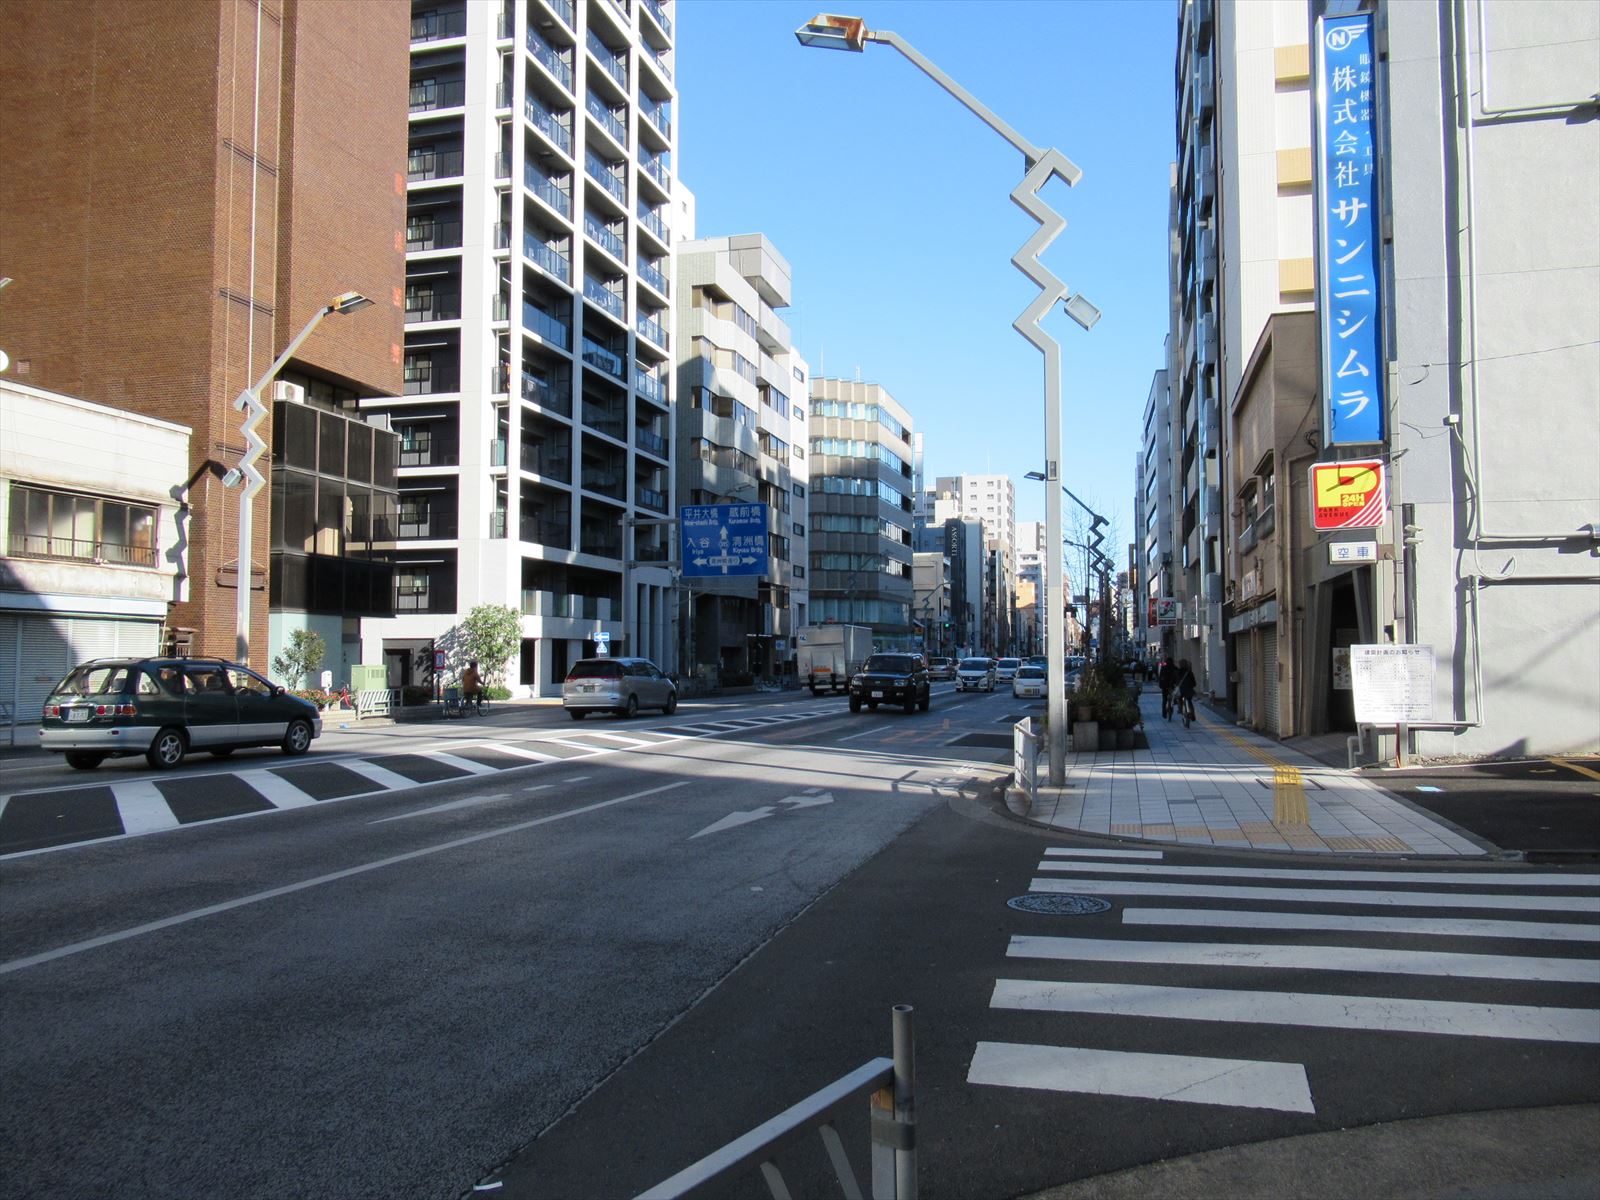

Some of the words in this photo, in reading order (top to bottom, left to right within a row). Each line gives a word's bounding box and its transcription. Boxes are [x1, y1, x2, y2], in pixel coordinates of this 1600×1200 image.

[1341, 494, 1365, 503] 24H
[685, 508, 718, 519] 平井大橋
[687, 537, 710, 547] 入谷
[1338, 547, 1369, 558] 空車
